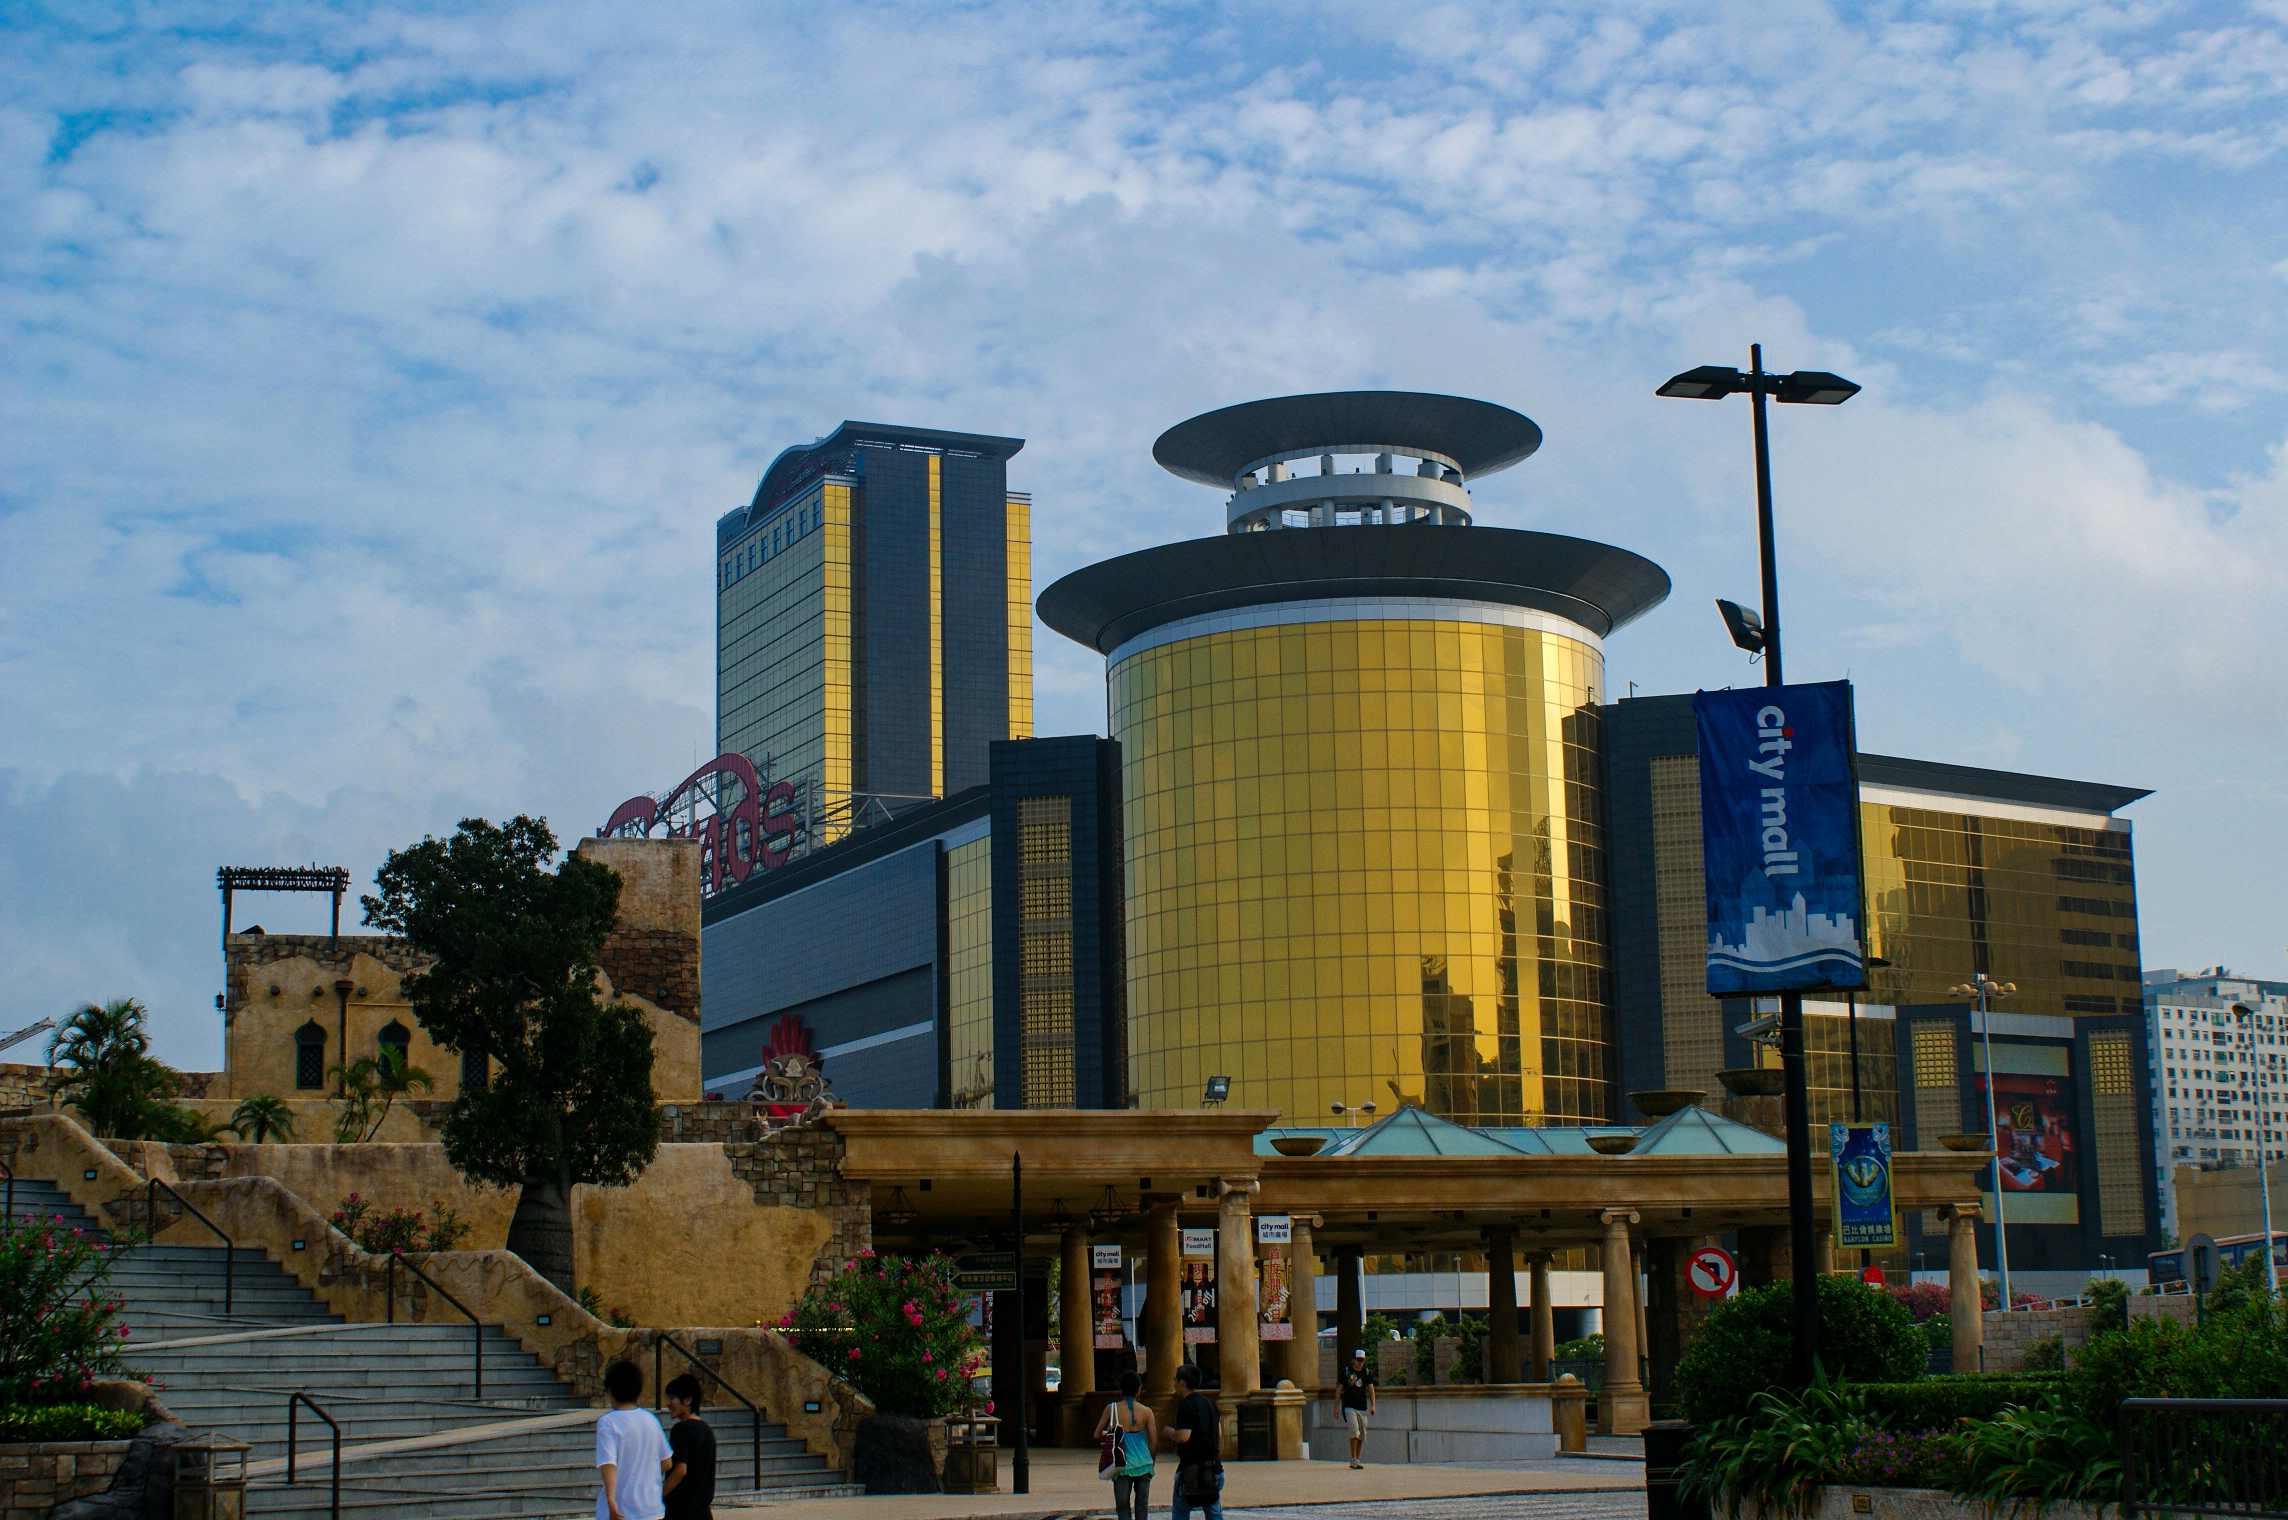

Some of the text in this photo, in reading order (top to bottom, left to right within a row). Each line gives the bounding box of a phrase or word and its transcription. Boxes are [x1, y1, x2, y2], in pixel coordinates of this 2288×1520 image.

[1749, 705, 1799, 877] city mall
[1260, 1222, 1273, 1231] city
[1262, 1231, 1288, 1239] 城市廣場
[1843, 1235, 1869, 1243] BABYLON
[1111, 1304, 1121, 1318] off
[1187, 1303, 1205, 1322] 20%
[1202, 1289, 1213, 1305] off
